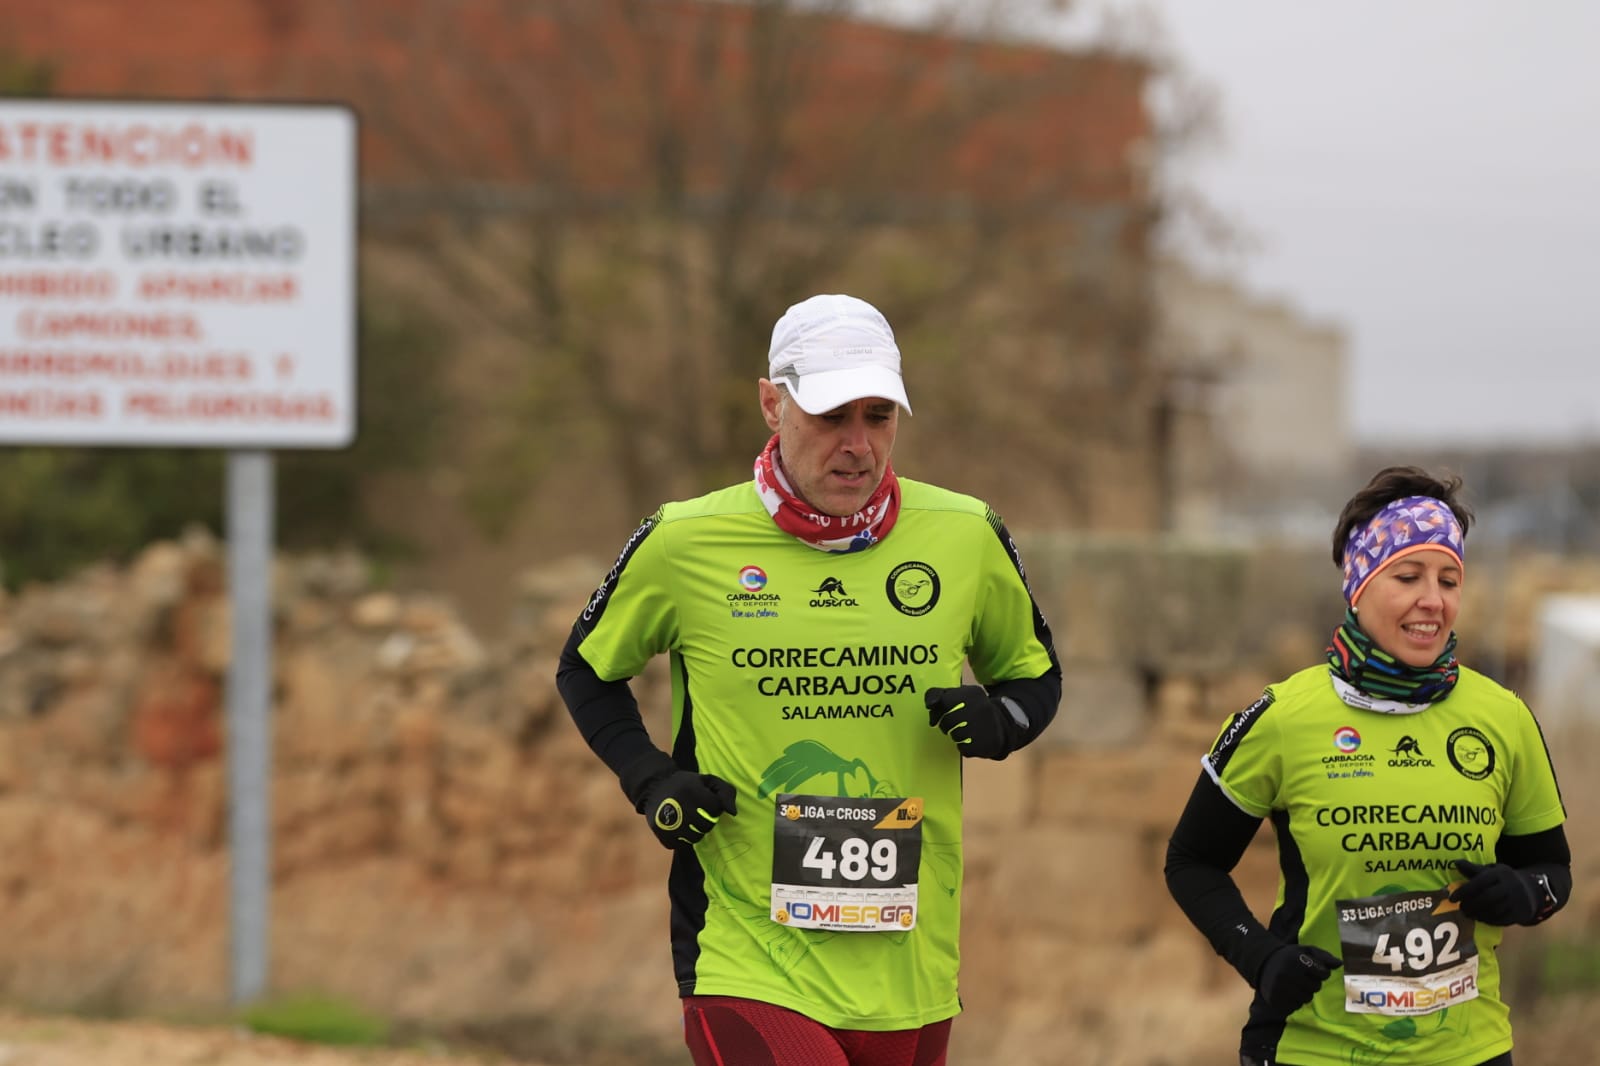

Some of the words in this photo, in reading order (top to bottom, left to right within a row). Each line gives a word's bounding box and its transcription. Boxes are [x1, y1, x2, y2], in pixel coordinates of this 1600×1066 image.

[63, 178, 177, 214] TODO
[197, 179, 242, 215] EL
[121, 225, 304, 262] URBANO
[138, 271, 297, 301] APARCAR
[726, 593, 781, 601] CARBAJOSA
[732, 644, 938, 668] CORRECAMINOS
[757, 674, 916, 697] CARBAJOSA
[782, 704, 894, 720] SALAMANCA
[1321, 754, 1376, 764] CARBAJOSA
[798, 806, 825, 819] LIGA
[836, 807, 877, 821] CROSS
[1316, 804, 1497, 827] CORRECAMINOS
[1341, 832, 1484, 852] CARBAJOSA
[802, 836, 897, 882] 489
[1364, 859, 1457, 873] SALAMANC
[1341, 908, 1357, 922] 33
[1358, 905, 1386, 920] LIGA
[1394, 896, 1433, 914] CROSS
[1371, 921, 1461, 972] 492
[1351, 975, 1476, 1008] JOMISAGA
